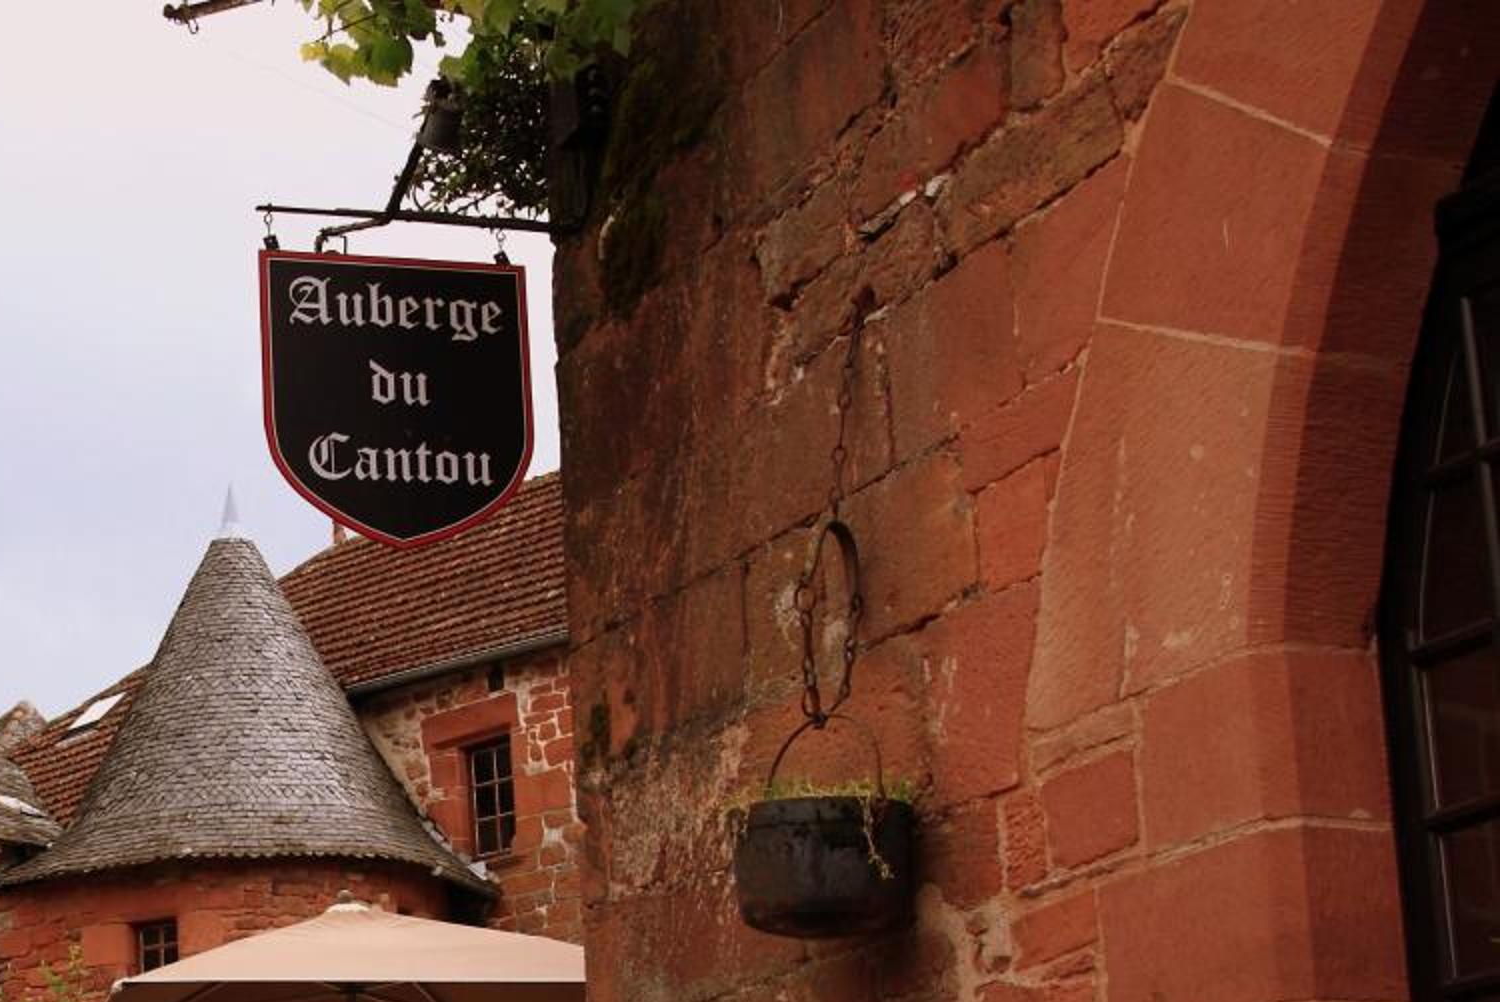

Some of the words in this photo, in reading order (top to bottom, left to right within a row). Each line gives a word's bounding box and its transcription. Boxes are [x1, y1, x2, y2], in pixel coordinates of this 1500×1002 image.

[289, 275, 503, 342] Auberge
[369, 359, 431, 406] du
[308, 431, 494, 487] Cantou
